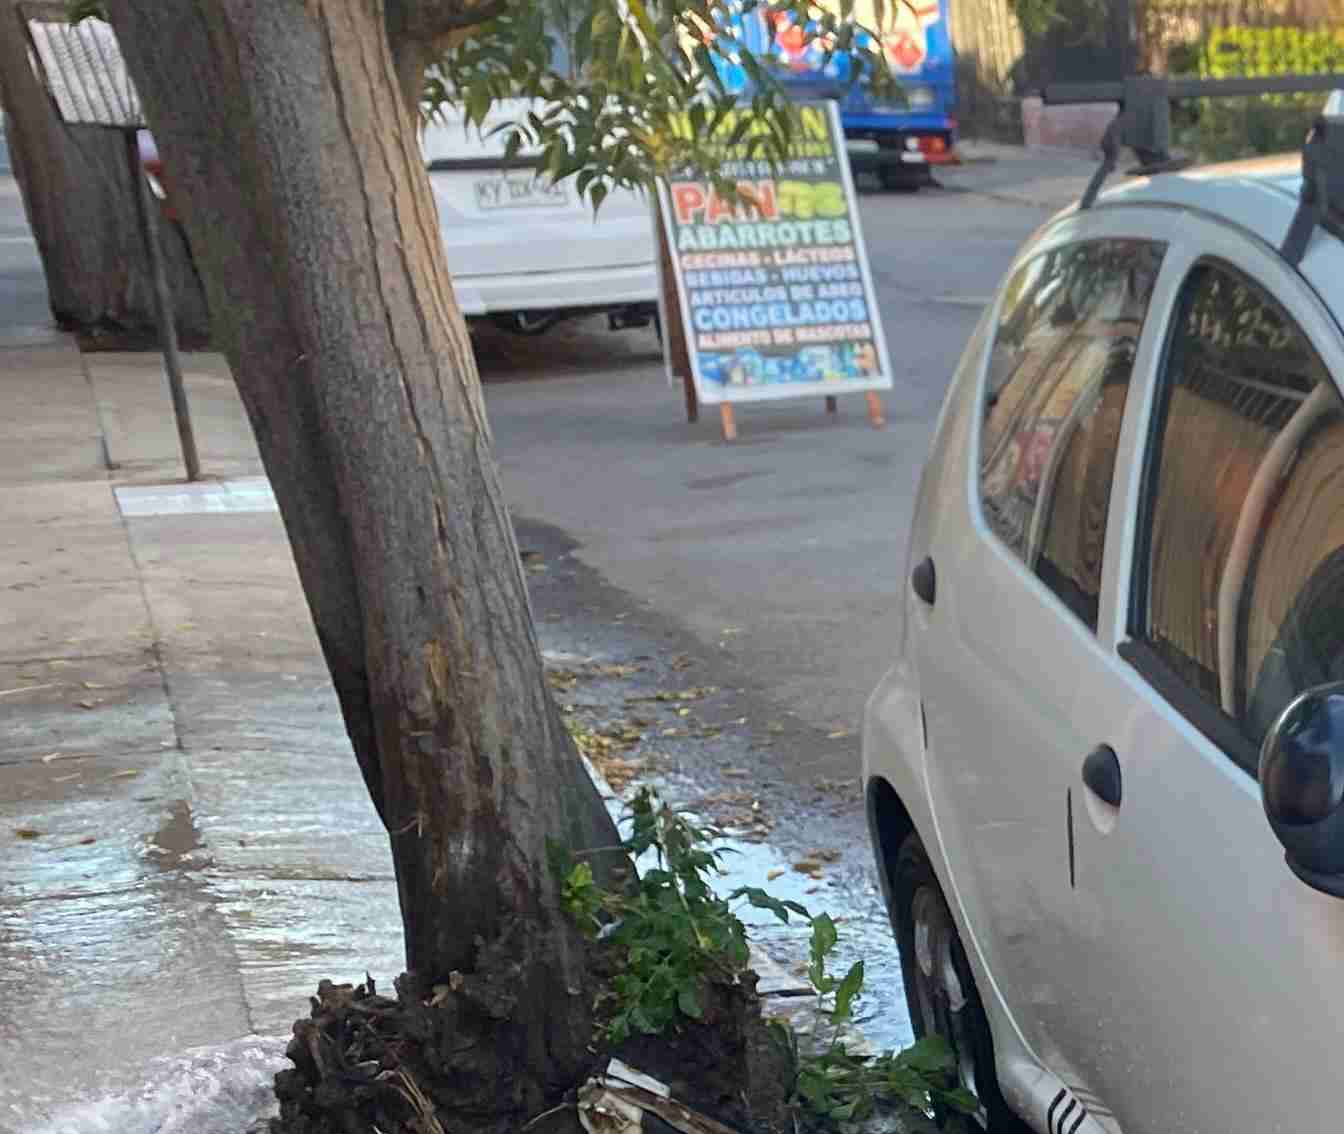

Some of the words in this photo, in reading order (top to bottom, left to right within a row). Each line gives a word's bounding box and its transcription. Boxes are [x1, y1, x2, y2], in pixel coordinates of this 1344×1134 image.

[678, 220, 850, 249] ABARROTES
[782, 263, 858, 283] HUEVOS
[695, 299, 867, 330] CONGELADOS
